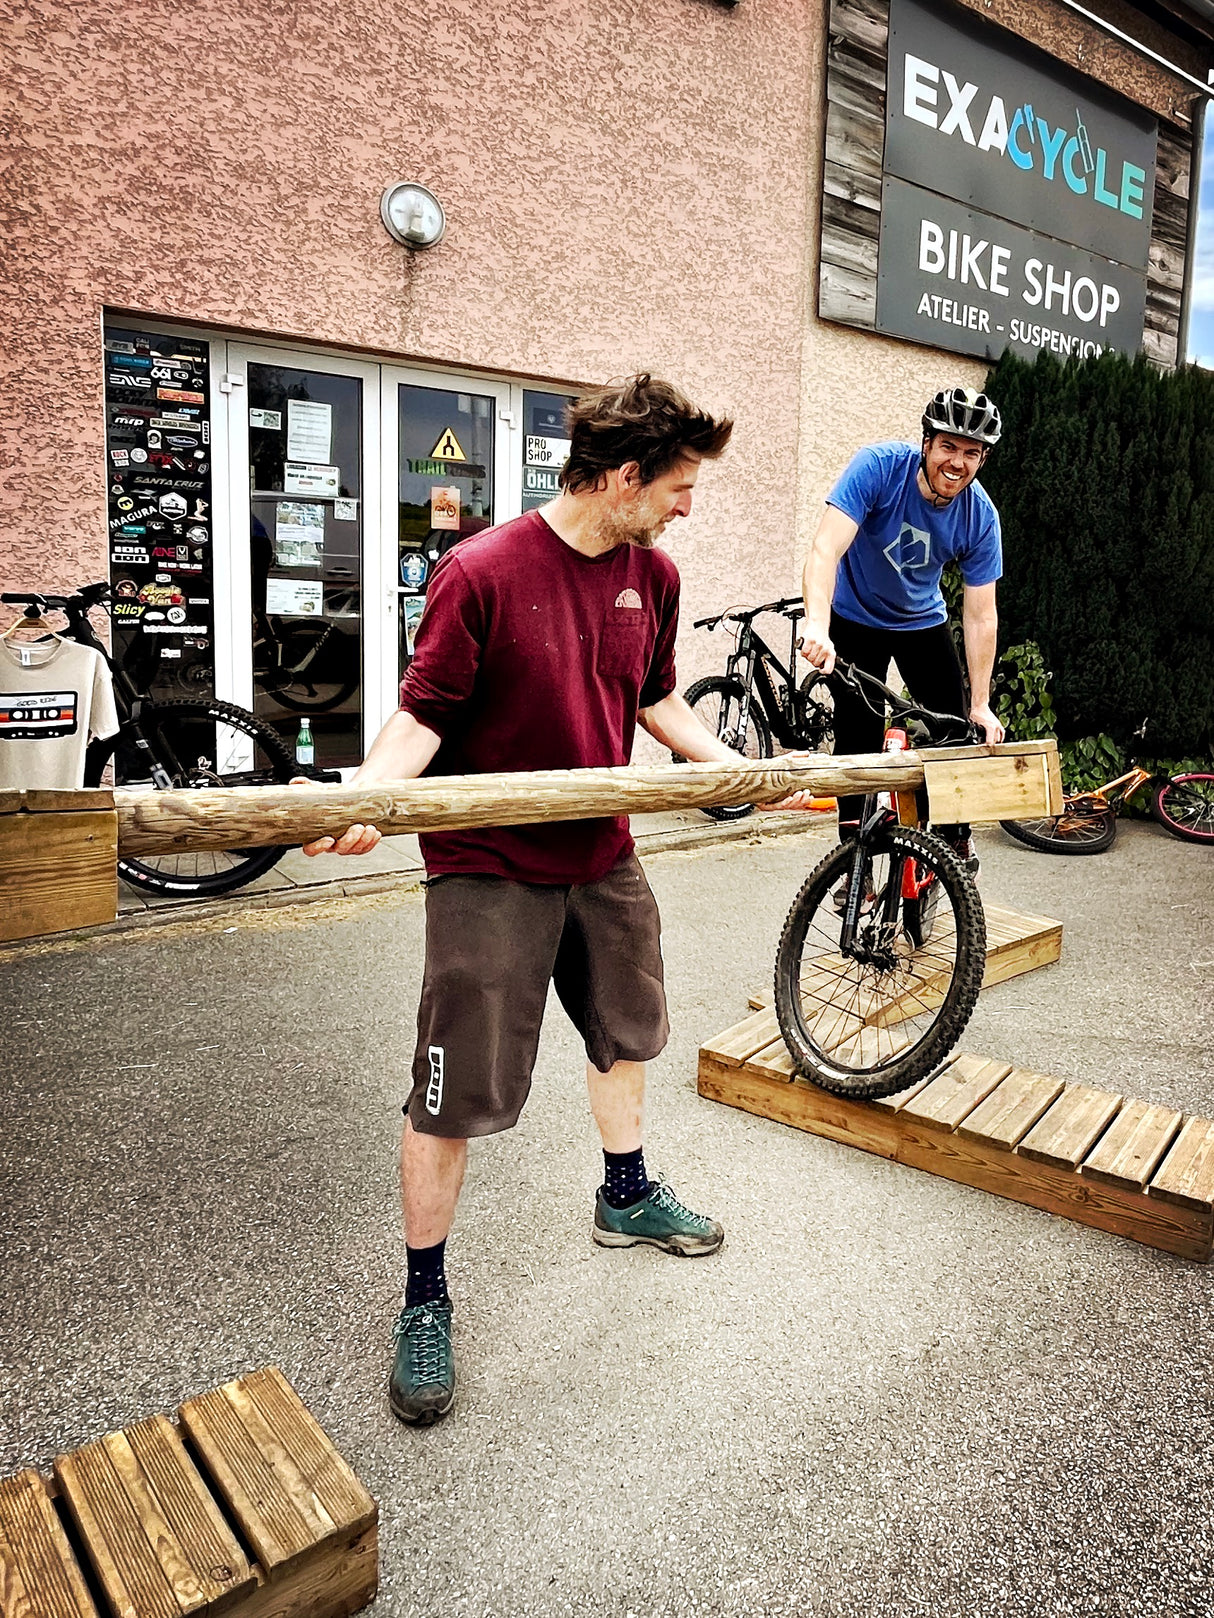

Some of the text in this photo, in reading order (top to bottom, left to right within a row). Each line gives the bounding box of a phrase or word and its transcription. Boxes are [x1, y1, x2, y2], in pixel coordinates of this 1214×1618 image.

[903, 53, 1146, 220] EXACYCLE
[918, 219, 1120, 328] BIKE SHOP
[917, 292, 991, 334] ATELIER
[1009, 318, 1115, 360] SUSPENSION
[528, 437, 547, 450] PRO
[528, 449, 553, 462] SHOP
[133, 476, 173, 487] SANTA
[109, 505, 158, 529] MAGURA
[113, 604, 146, 617] Slicy
[893, 836, 939, 865] MAXXIS
